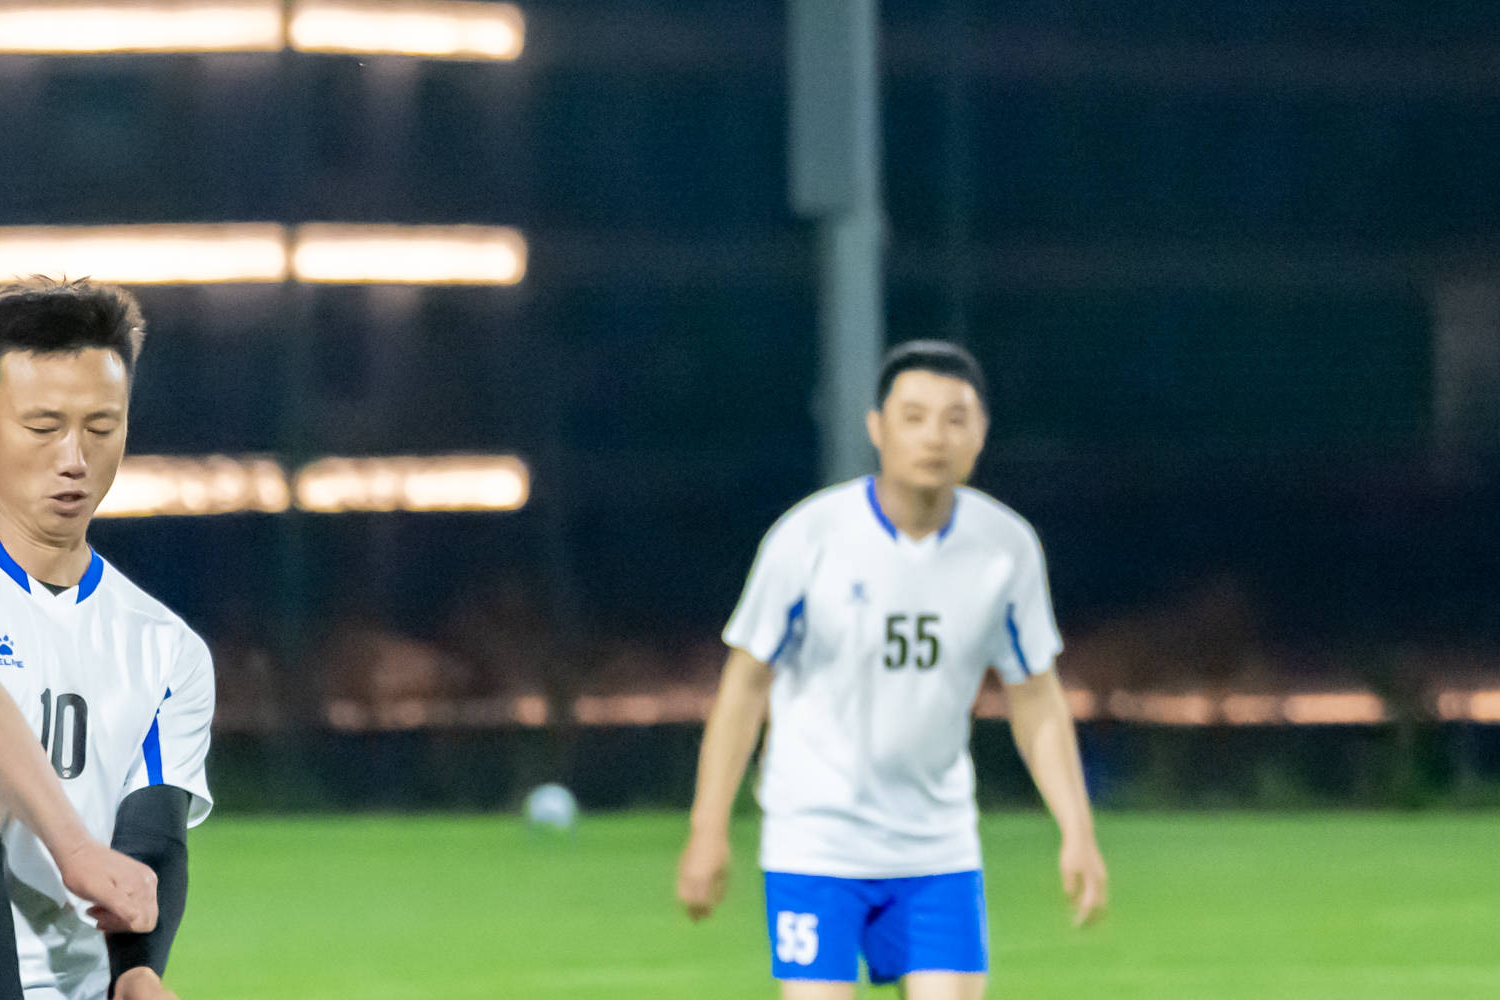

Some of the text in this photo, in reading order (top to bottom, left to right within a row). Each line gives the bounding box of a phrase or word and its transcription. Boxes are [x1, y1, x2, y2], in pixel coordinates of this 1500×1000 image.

[885, 613, 941, 671] 55
[40, 687, 88, 780] 10
[776, 910, 819, 966] 55
